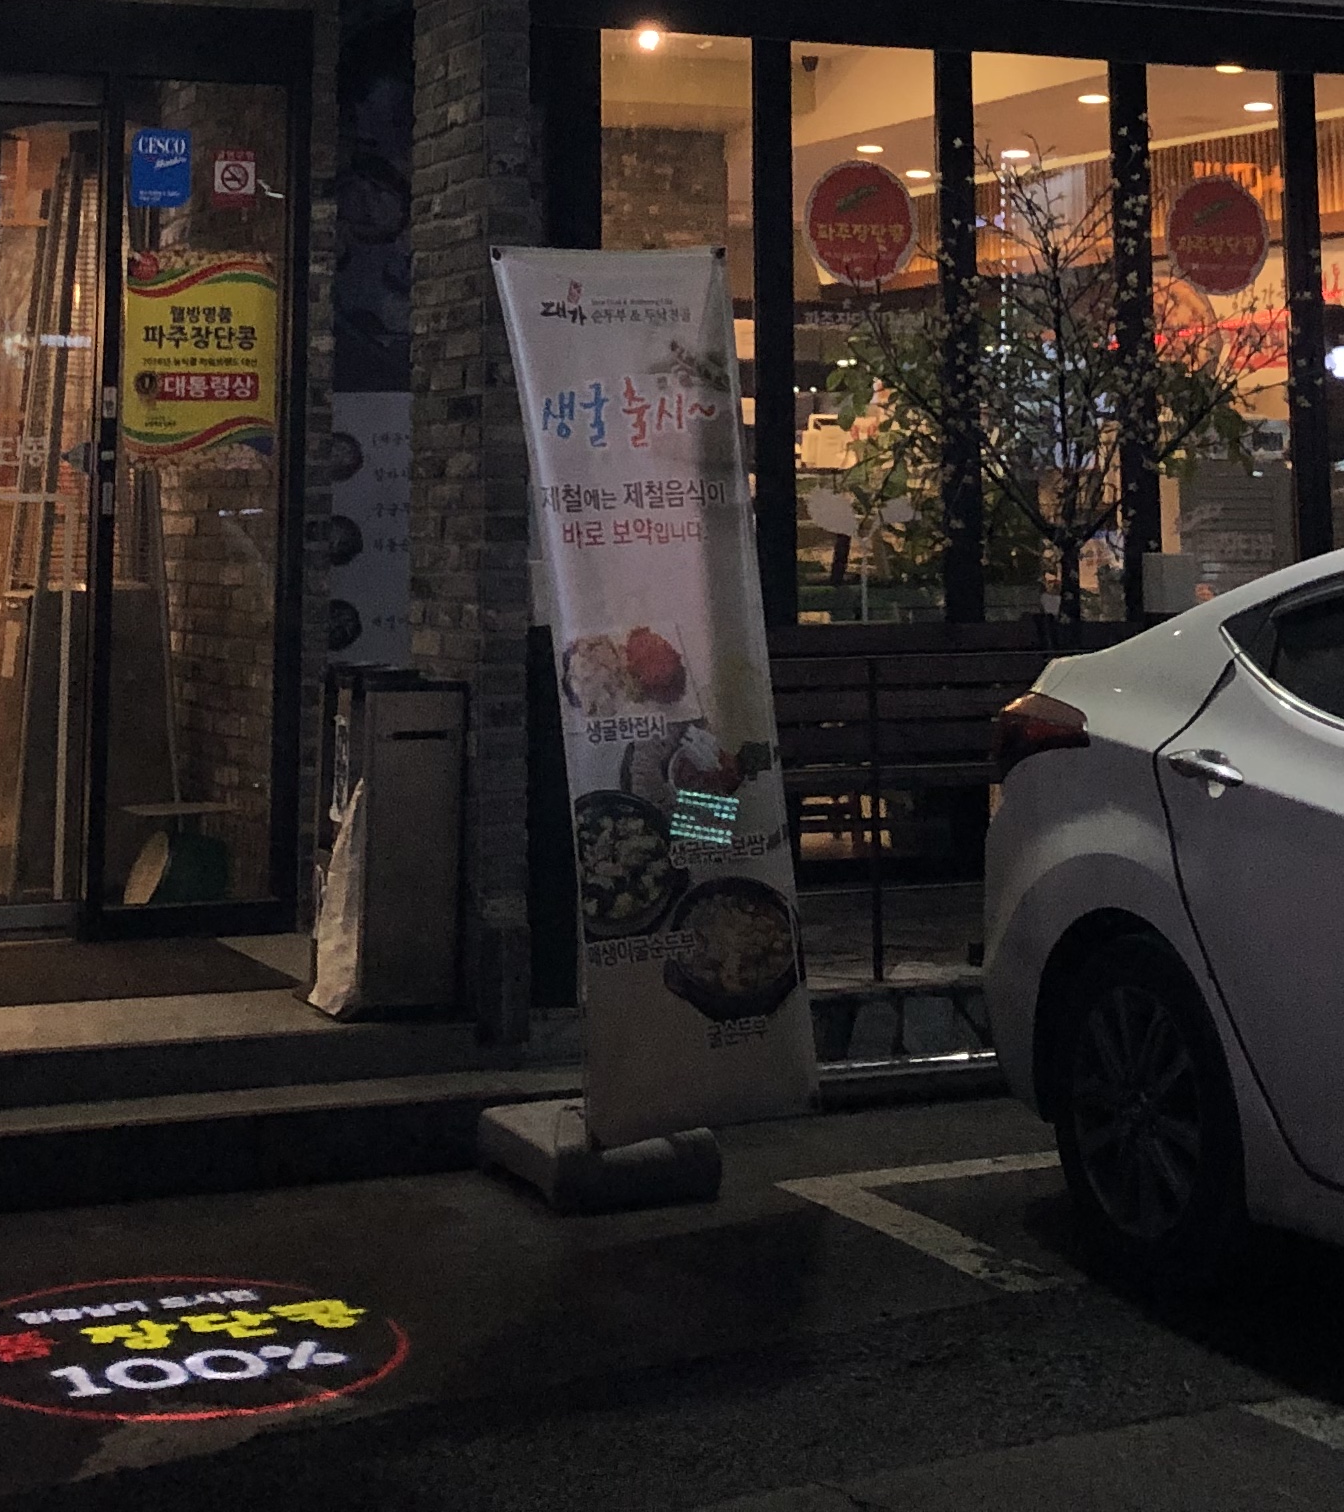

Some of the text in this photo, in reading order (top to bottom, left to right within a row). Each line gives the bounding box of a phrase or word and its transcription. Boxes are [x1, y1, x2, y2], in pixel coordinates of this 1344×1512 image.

[137, 135, 186, 155] CESCO
[143, 325, 258, 350] 파주장단콩
[163, 375, 256, 399] 대통령상
[622, 479, 726, 511] 제철음식이
[561, 520, 606, 547] 바로
[585, 714, 668, 744] 생굴한접시
[79, 1298, 367, 1351] 장단콩
[50, 1340, 349, 1399] 100%
